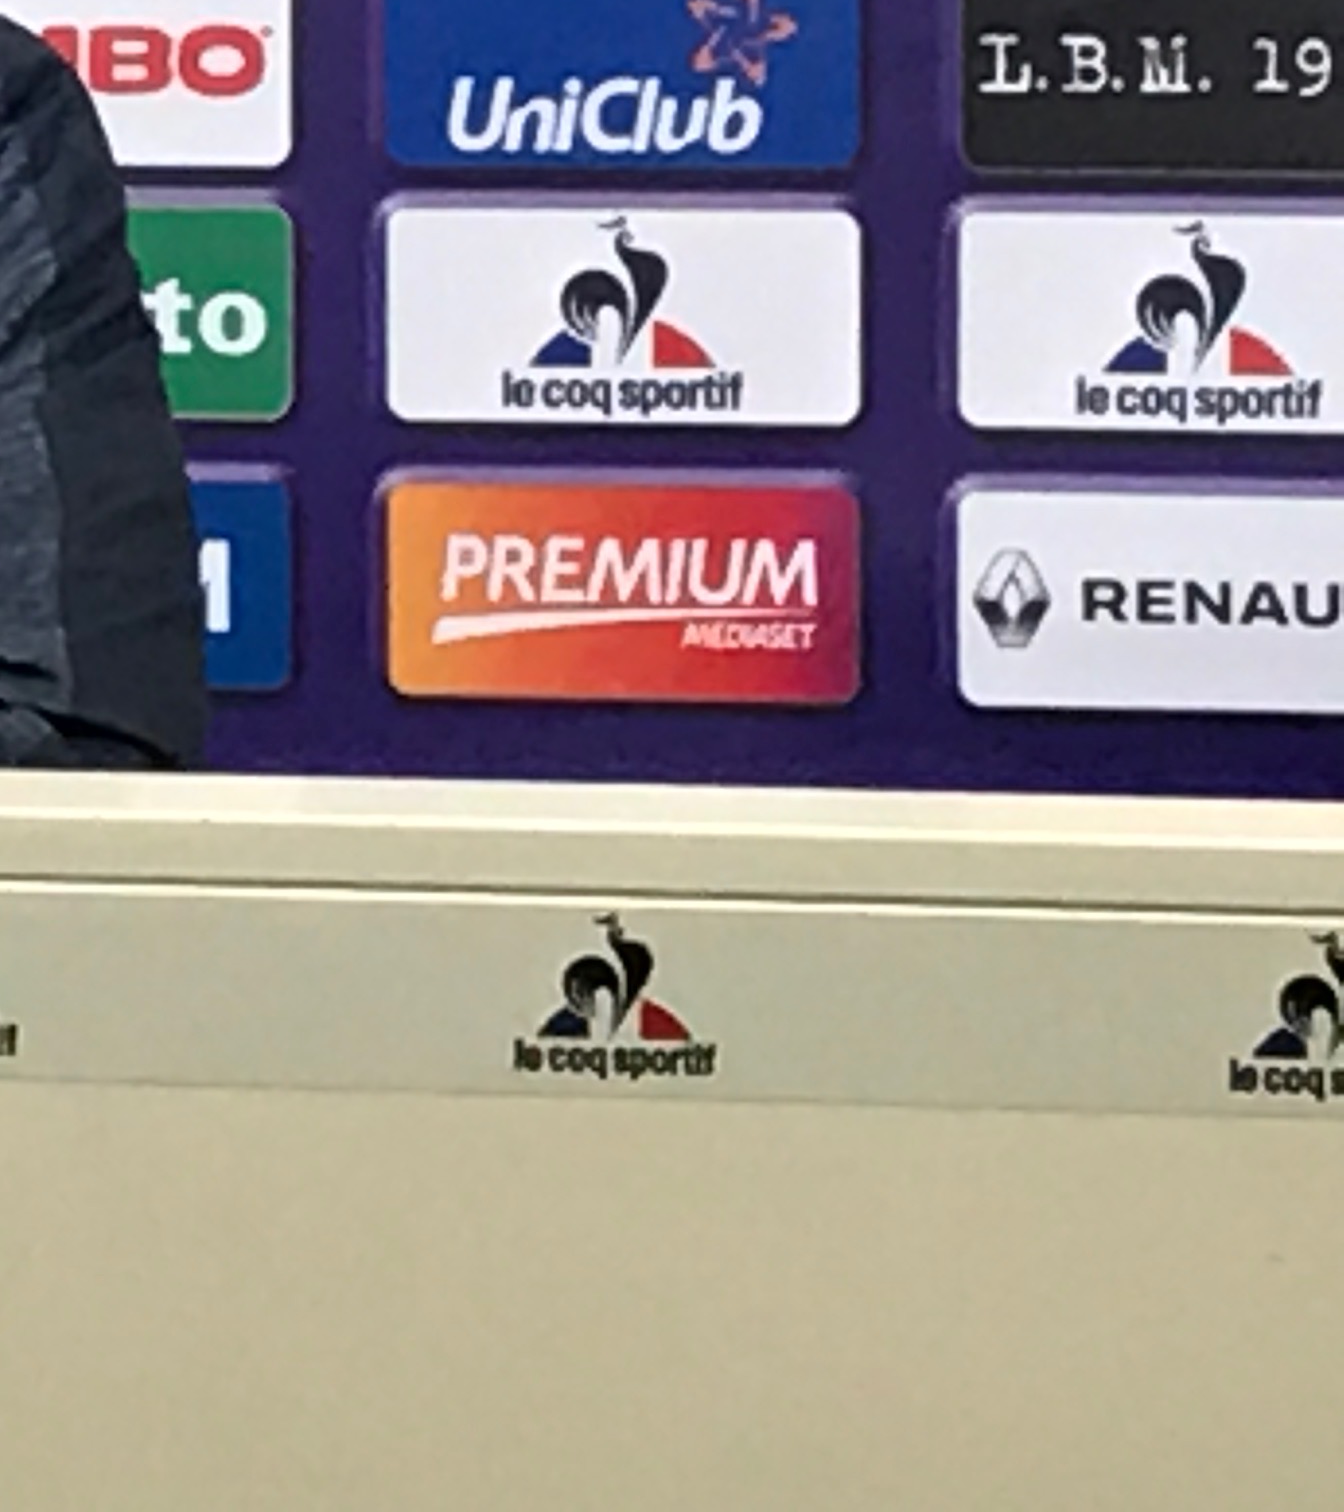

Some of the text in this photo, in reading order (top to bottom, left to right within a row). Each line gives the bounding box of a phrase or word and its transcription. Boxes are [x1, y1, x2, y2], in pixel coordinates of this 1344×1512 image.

[979, 33, 1333, 97] L.B.M. 19
[447, 75, 763, 156] UniClub
[502, 372, 743, 418] le coq sportif
[1076, 375, 1323, 426] le coq sportif
[439, 532, 818, 607] PREMIUM
[1081, 577, 1341, 628] RENAU
[681, 621, 816, 652] MEDIASET
[548, 1047, 607, 1079] coq
[1264, 1067, 1324, 1102] coq
